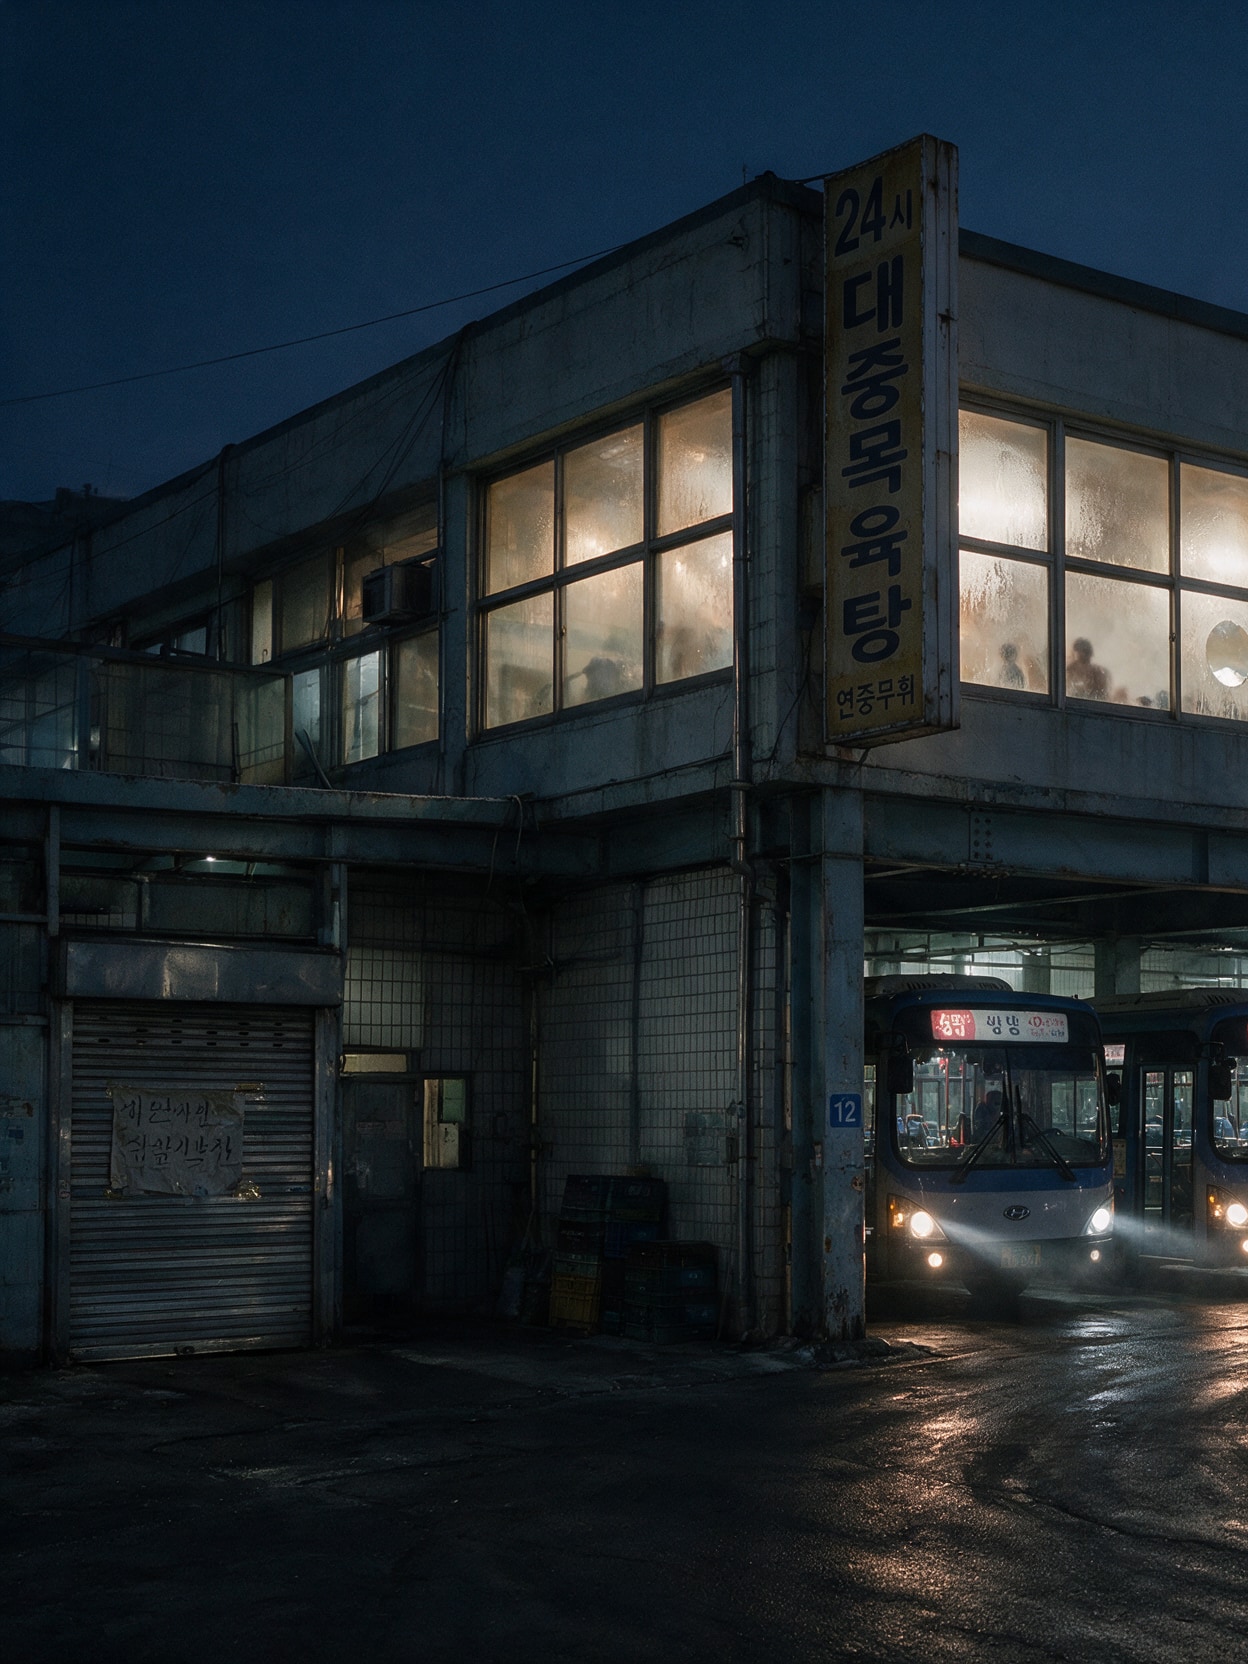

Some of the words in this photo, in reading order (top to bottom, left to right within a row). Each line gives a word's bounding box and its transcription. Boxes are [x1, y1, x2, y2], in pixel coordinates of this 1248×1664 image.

[834, 175, 913, 258] 24시
[840, 254, 913, 664] 대중목육탕
[833, 1099, 857, 1123] 12
